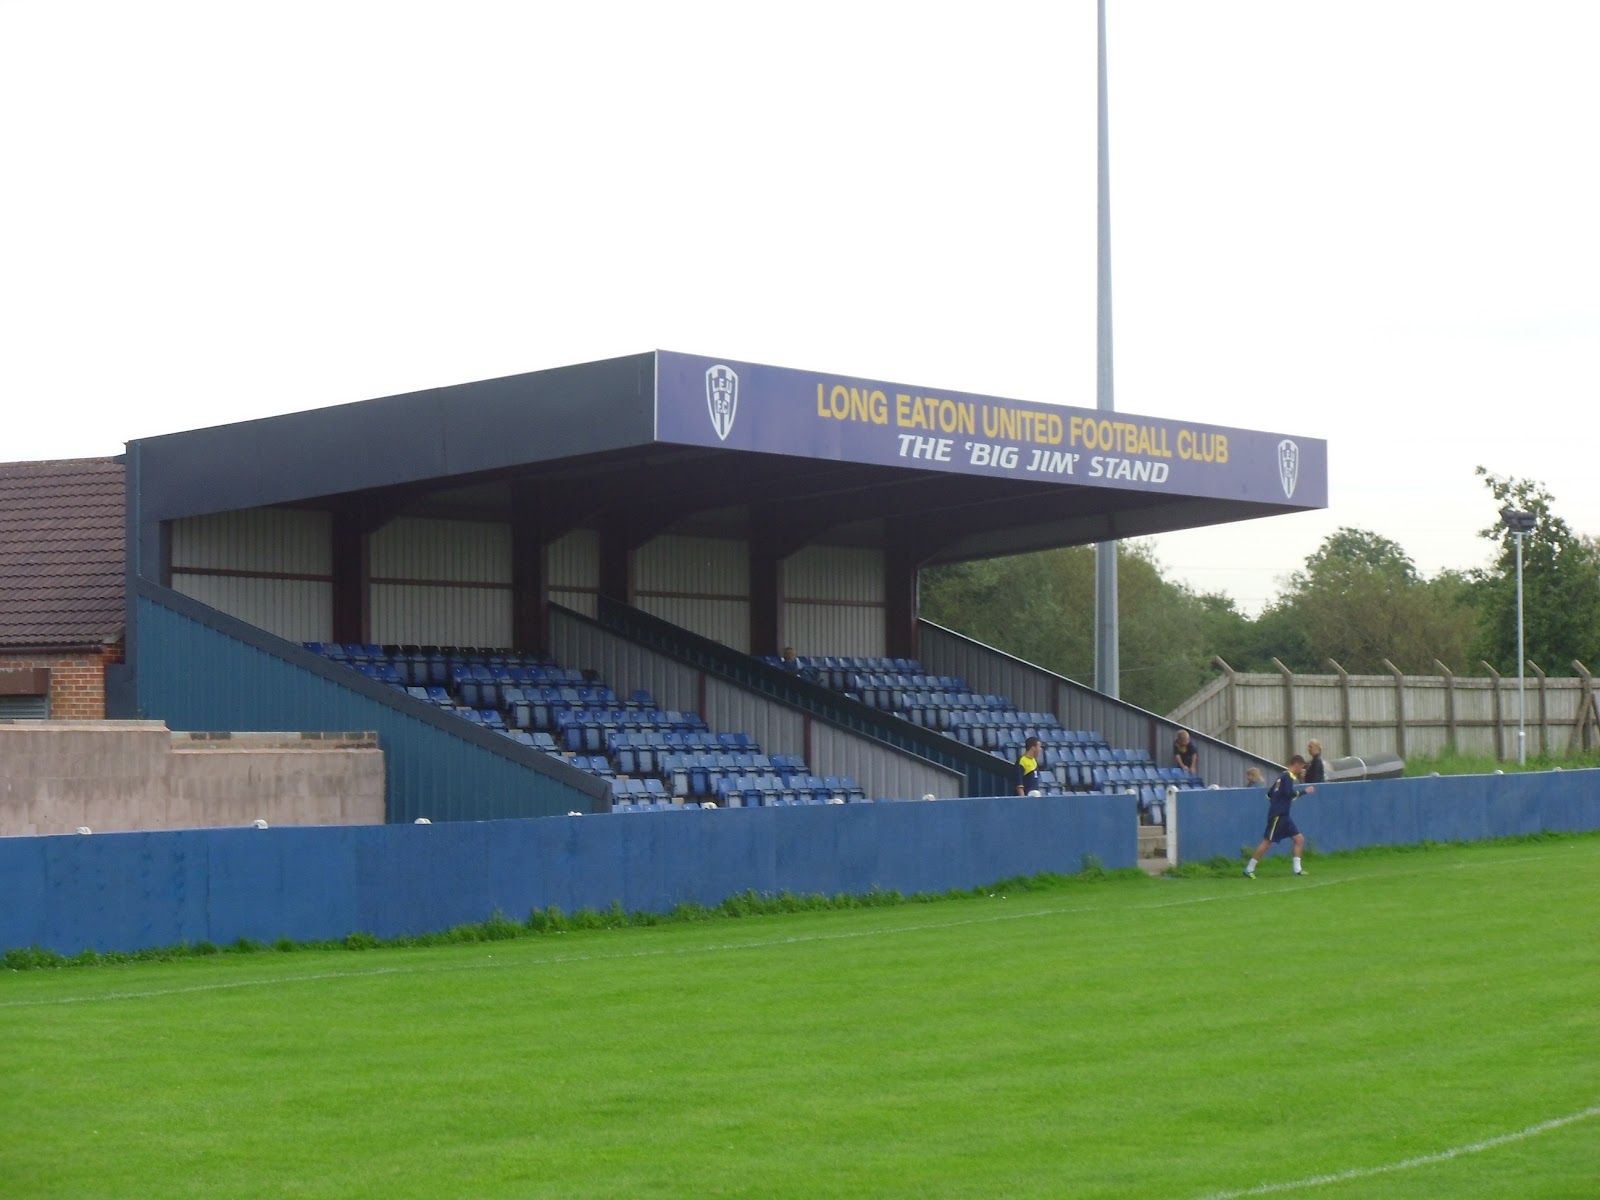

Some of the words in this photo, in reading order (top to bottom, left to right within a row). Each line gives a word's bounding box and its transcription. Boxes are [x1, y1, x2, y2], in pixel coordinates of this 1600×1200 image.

[817, 383, 888, 424] LONG
[896, 394, 975, 435] EATON
[982, 405, 1063, 445] UNITED
[1070, 416, 1172, 457] FOOTBALL
[1177, 430, 1229, 463] CLUB
[898, 433, 954, 462] THE
[1088, 456, 1170, 484] STAND
